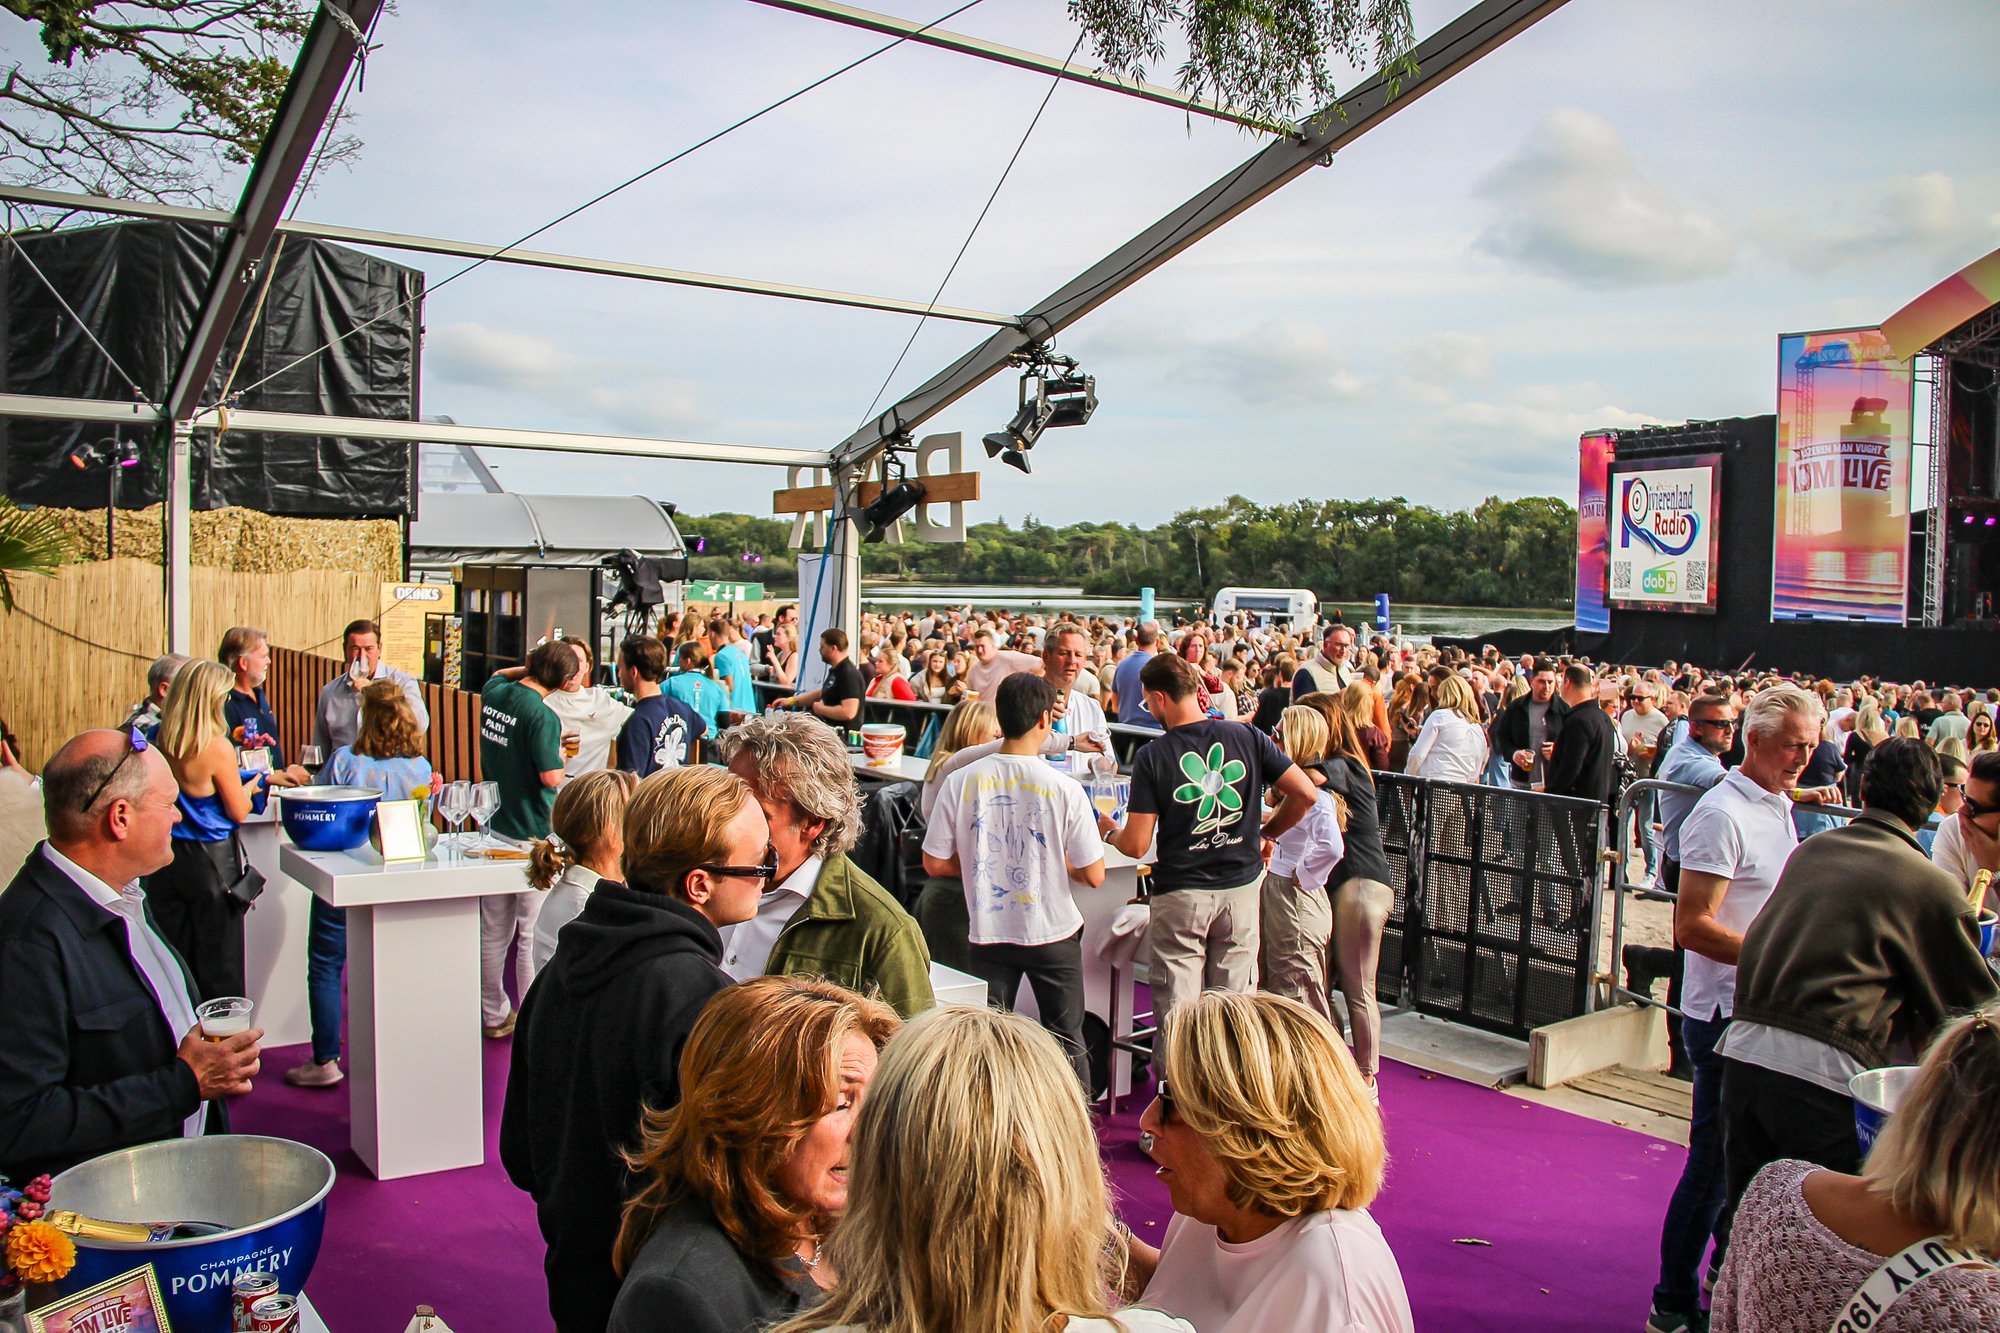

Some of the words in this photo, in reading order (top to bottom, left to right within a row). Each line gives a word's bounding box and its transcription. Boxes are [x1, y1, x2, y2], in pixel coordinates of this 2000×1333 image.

[1833, 443, 1853, 453] MAN
[1855, 444, 1883, 454] VUGHT
[1843, 458, 1892, 491] LIVE
[1654, 510, 1687, 536] Radio
[396, 587, 440, 601] DRINKS
[485, 718, 506, 733] PARIS
[294, 812, 337, 822] POMMERY
[1188, 837, 1210, 851] Les
[1211, 832, 1244, 848] Deux
[200, 1246, 274, 1271] CHAMPAGNE
[1885, 1242, 1973, 1294] UTY
[102, 1303, 132, 1329] LIVE
